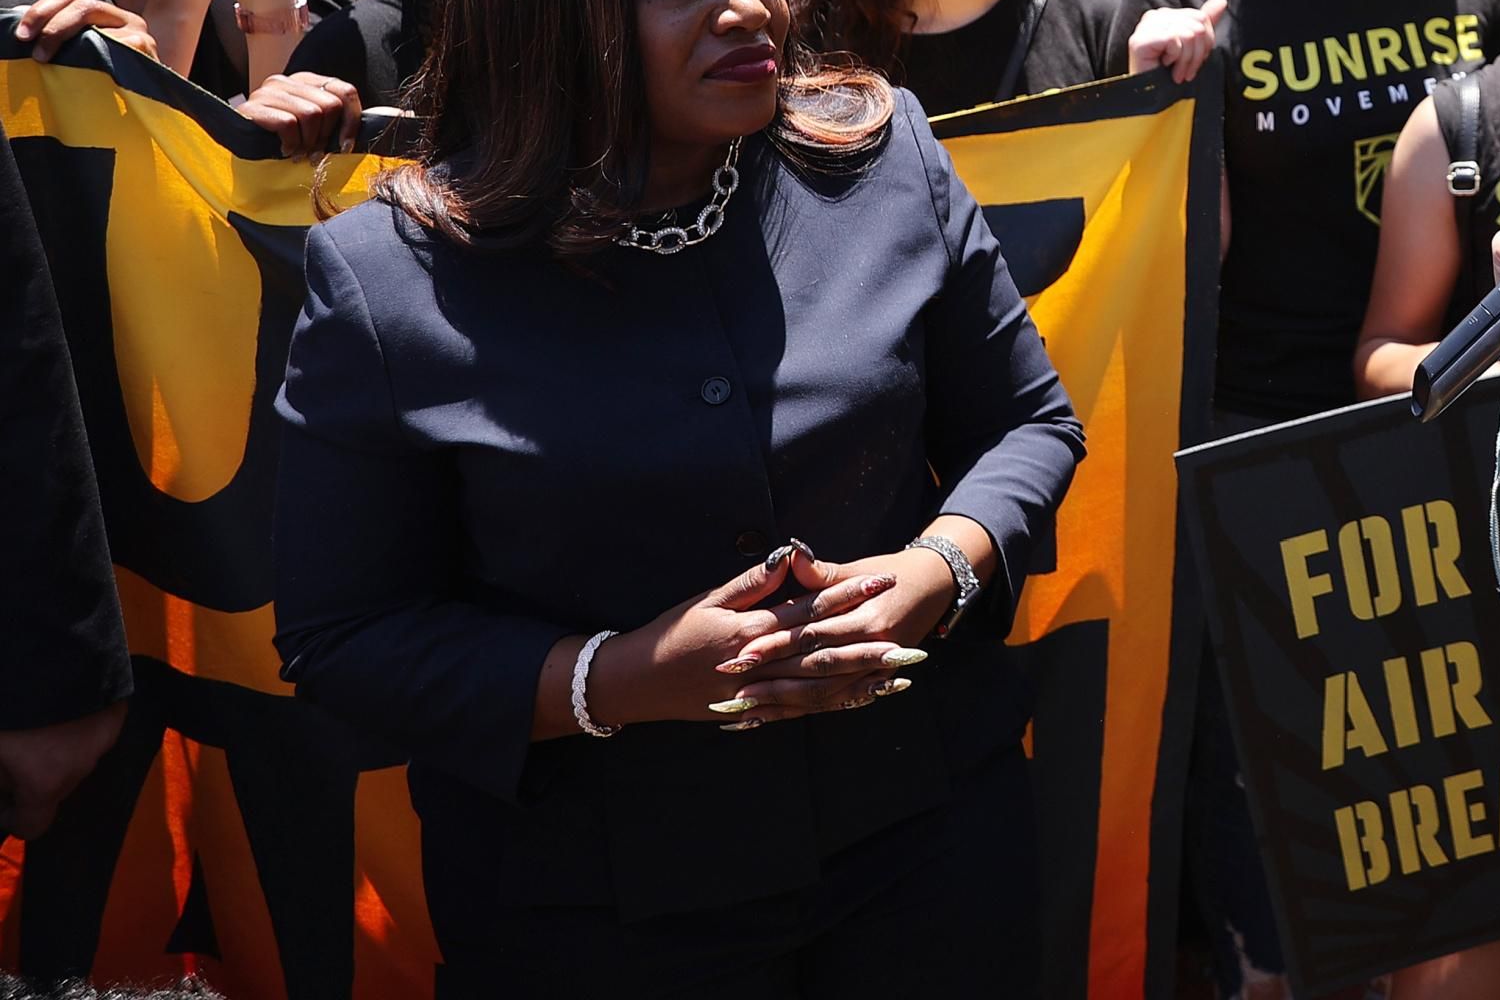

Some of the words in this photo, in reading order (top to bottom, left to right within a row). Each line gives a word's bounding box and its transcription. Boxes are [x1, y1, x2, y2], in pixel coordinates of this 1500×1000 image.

[1240, 13, 1484, 101] SUNRISE
[1256, 71, 1468, 132] MOVEME
[1279, 499, 1472, 640] FOR
[1321, 640, 1494, 771] AIR
